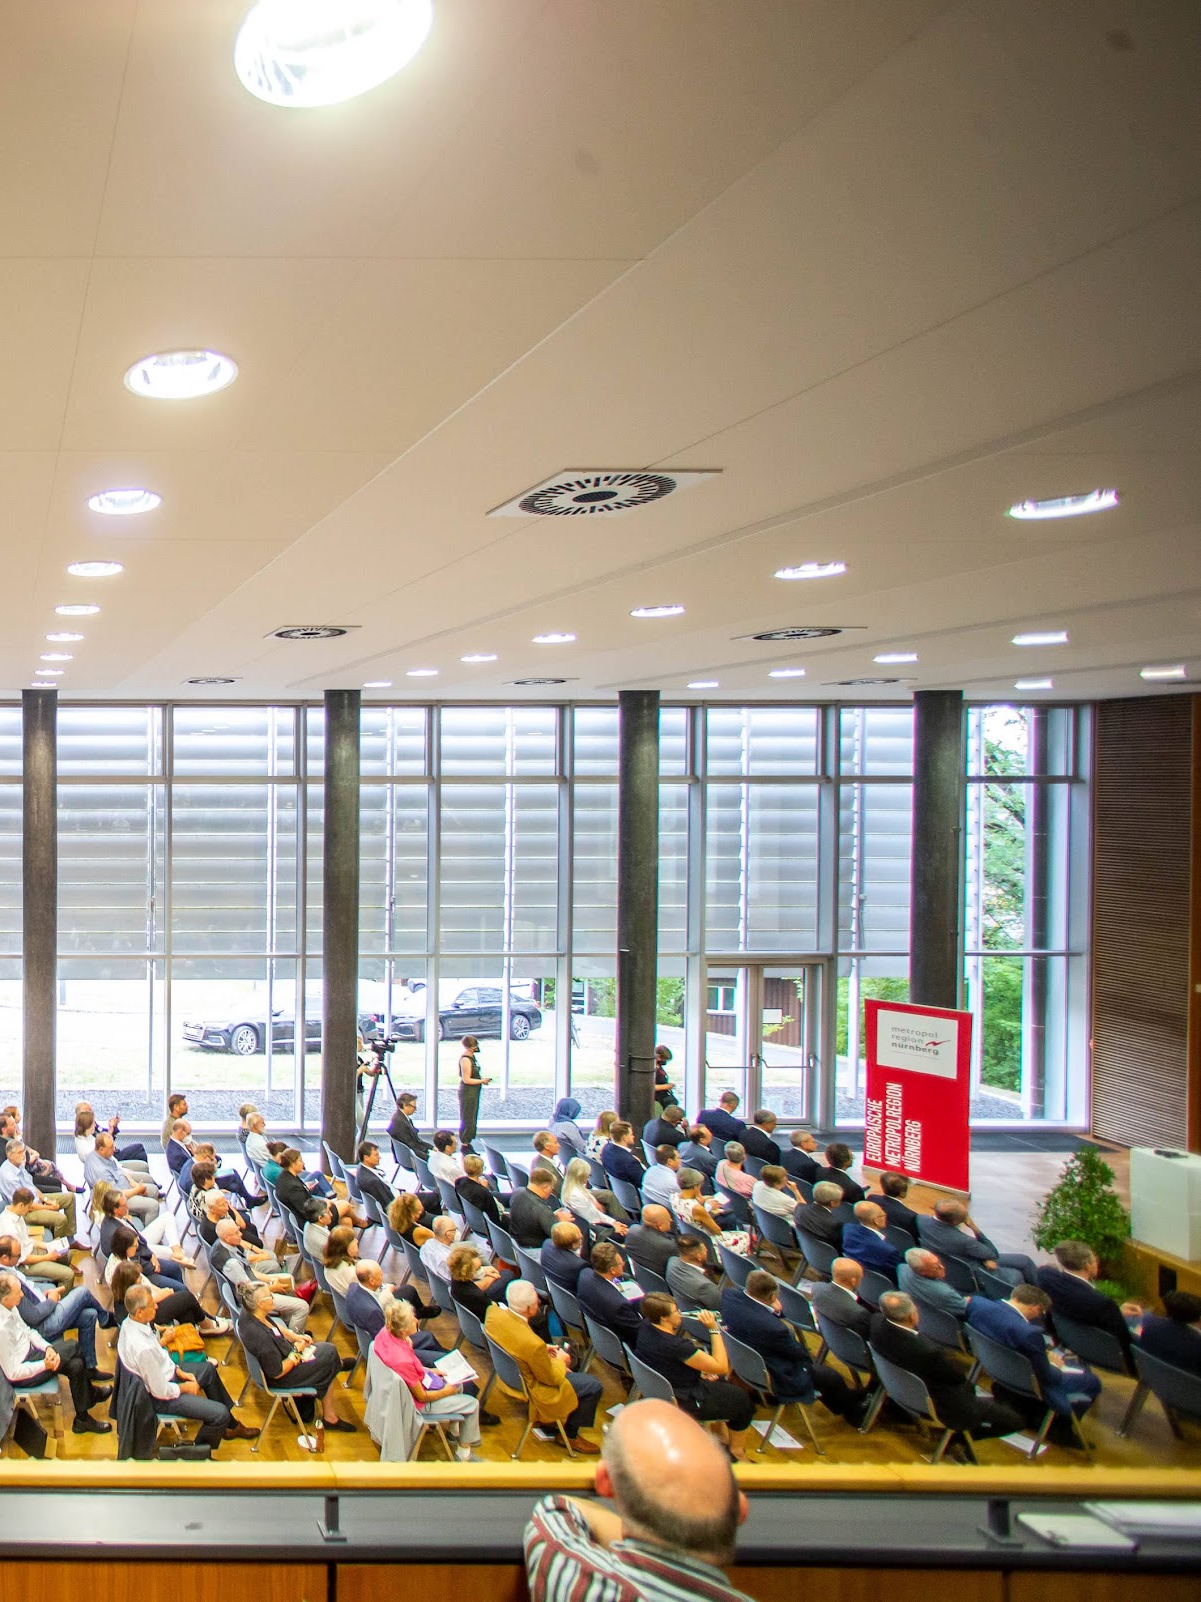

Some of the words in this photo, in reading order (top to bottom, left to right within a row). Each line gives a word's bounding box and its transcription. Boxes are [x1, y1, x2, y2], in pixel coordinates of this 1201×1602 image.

[891, 1026, 938, 1038] metropol
[891, 1034, 924, 1044] region
[865, 1098, 882, 1162] EUROPÄISCHE
[884, 1082, 902, 1167] METROPOLREGION
[902, 1119, 921, 1172] NÜRNBERG
